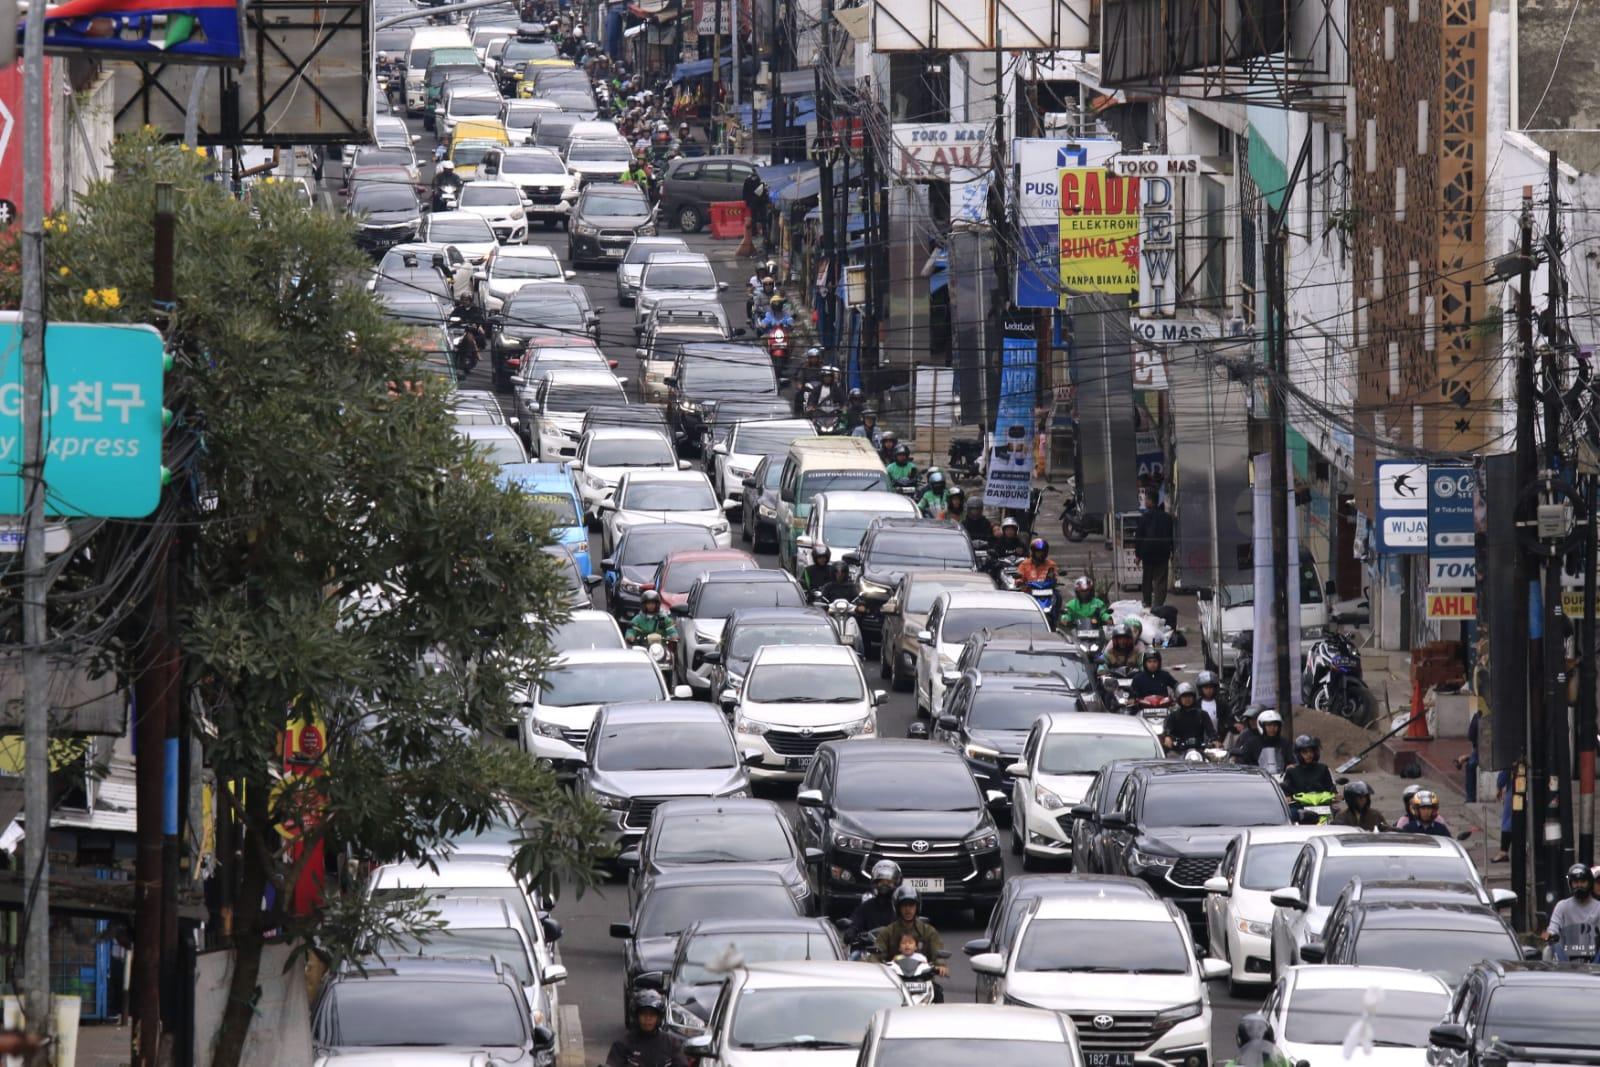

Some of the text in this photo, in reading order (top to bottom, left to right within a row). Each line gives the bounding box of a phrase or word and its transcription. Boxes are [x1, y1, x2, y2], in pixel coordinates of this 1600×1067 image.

[912, 129, 985, 141] TOKO MAS
[1119, 160, 1197, 174] TOKO MAS
[1072, 219, 1138, 230] ELEKTRONI
[1061, 237, 1119, 258] BUNGA
[1142, 176, 1175, 317] DEWI
[1067, 276, 1094, 285] TANPA
[1097, 275, 1122, 285] BIAYA
[1162, 324, 1202, 341] MAS
[67, 381, 145, 424] 친구
[47, 436, 140, 461] xpress
[986, 489, 1029, 499] BANDUNG
[911, 880, 943, 888] 1200 TT
[1089, 1053, 1110, 1065] 1827
